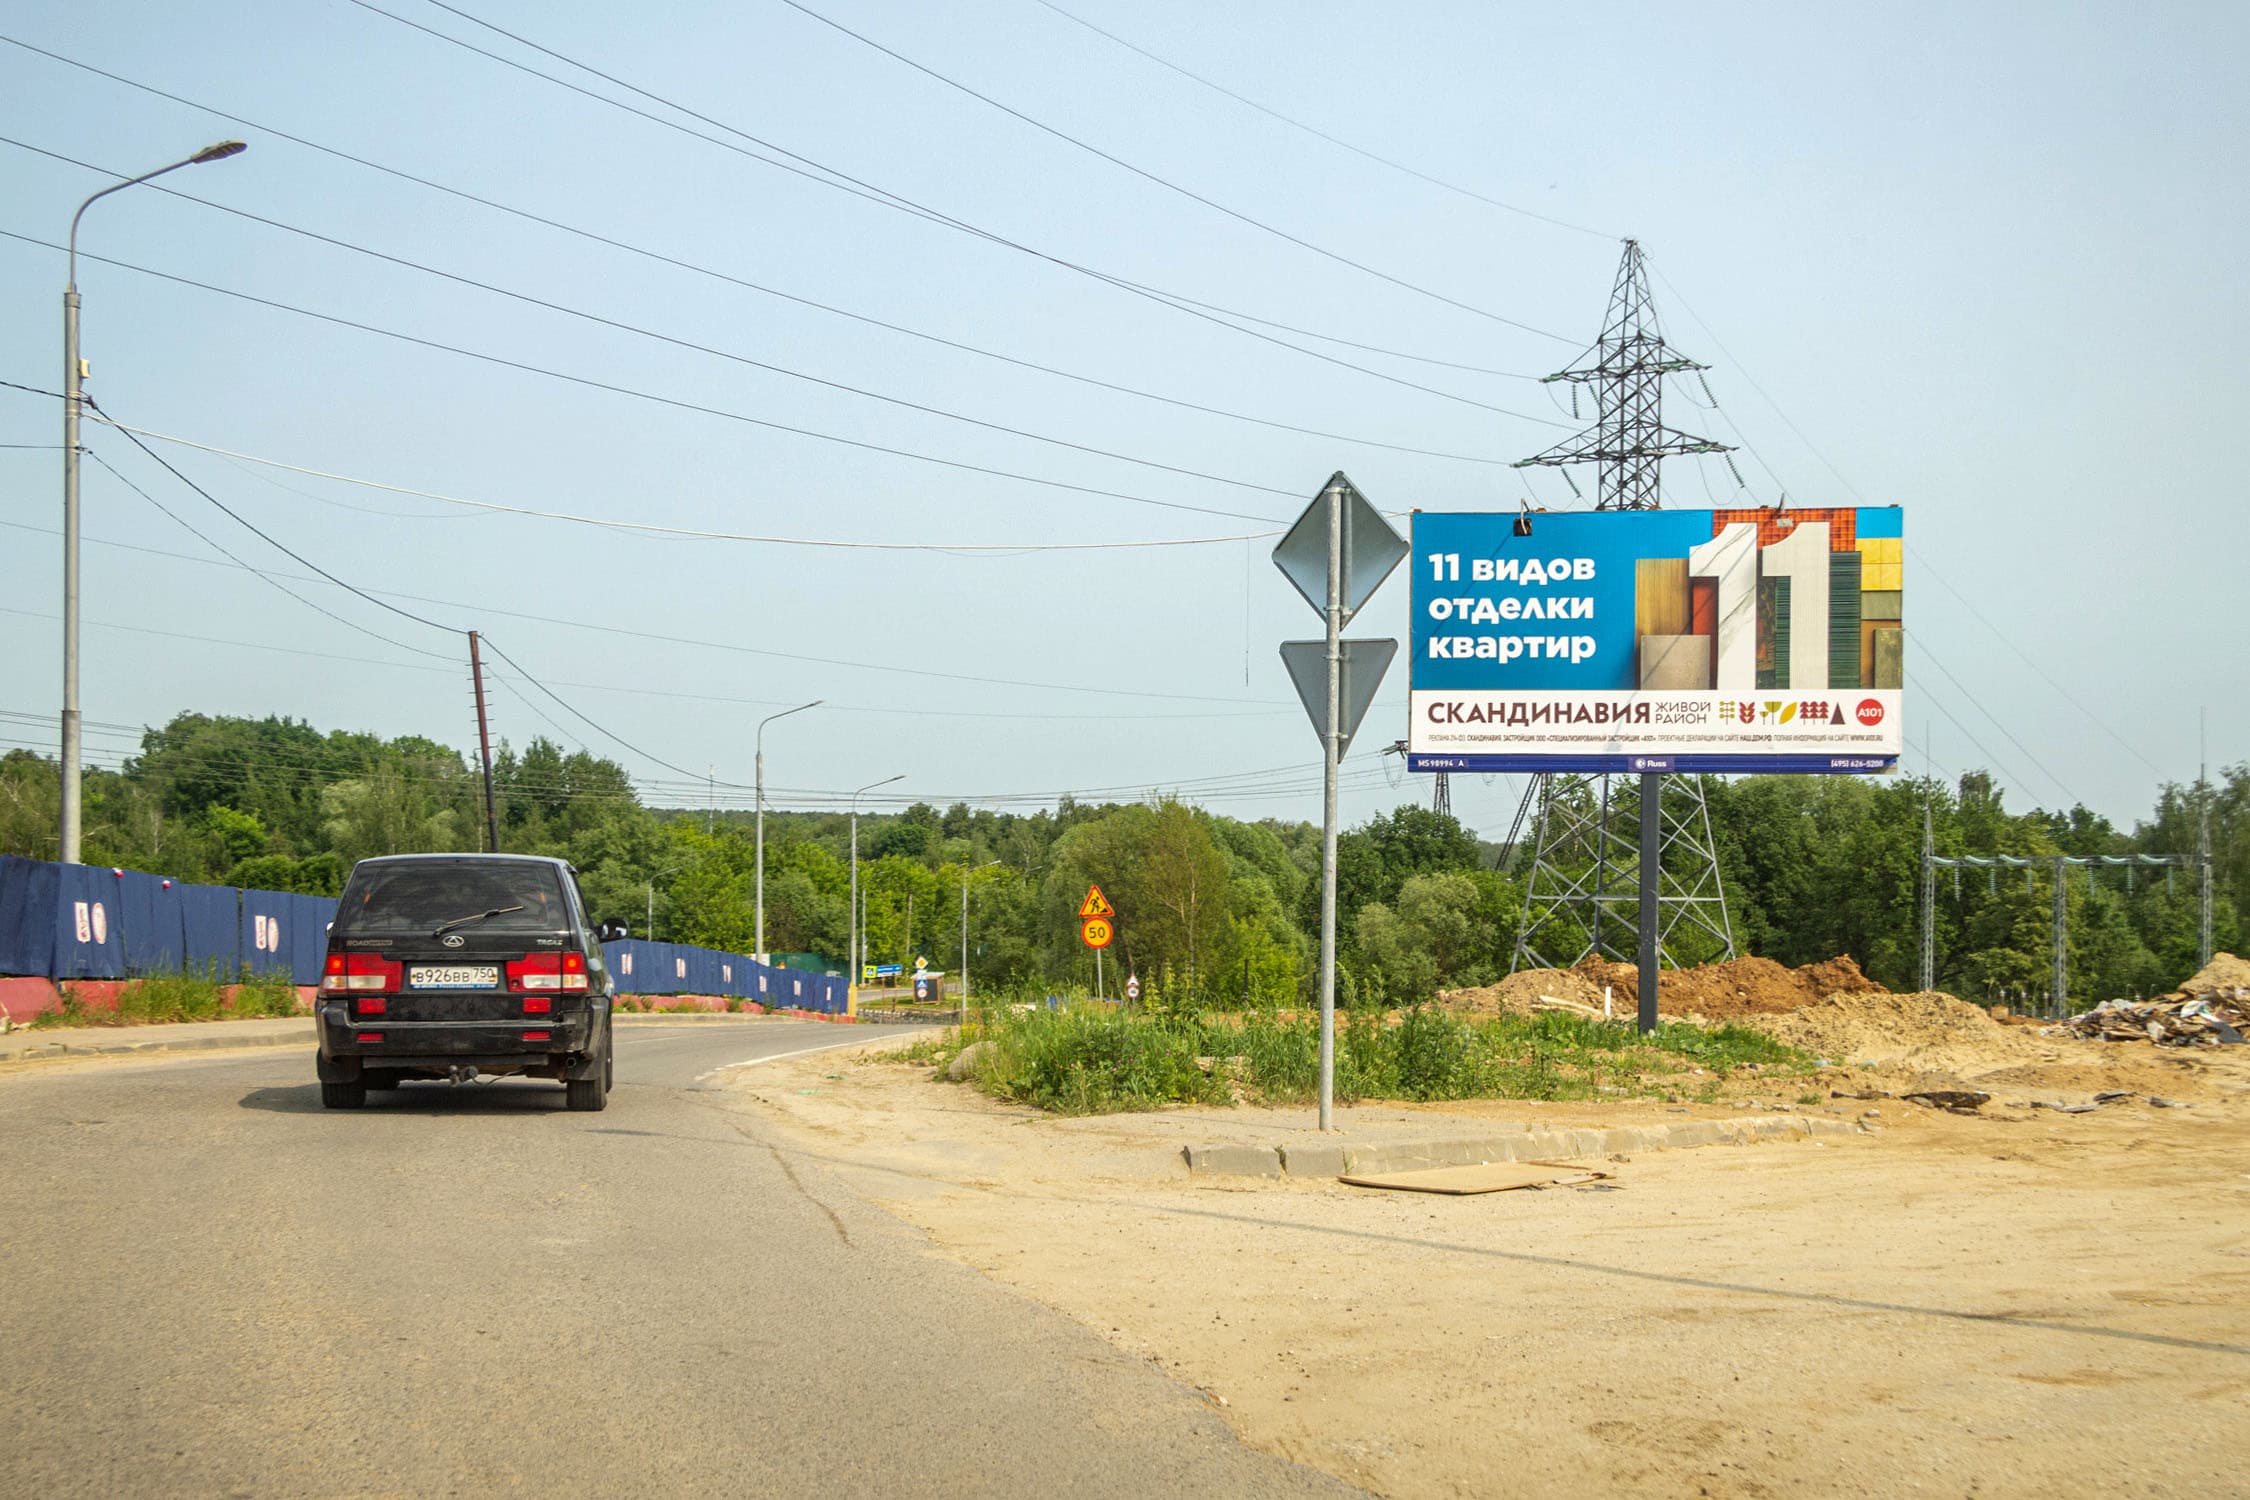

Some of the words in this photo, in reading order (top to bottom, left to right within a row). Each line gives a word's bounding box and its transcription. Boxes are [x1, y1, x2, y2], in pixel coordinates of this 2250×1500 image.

[1428, 553, 1460, 581] 11
[1472, 558, 1596, 586] видов
[1428, 597, 1594, 624] отделки
[1689, 522, 1830, 690] 11
[1428, 635, 1597, 664] квартир
[1427, 702, 1651, 727] СКАНДИНАВИЯ
[1655, 701, 1712, 713] ЖИВОЙ
[1655, 713, 1708, 725] РАЙОН
[1647, 760, 1667, 768] Russ
[1088, 927, 1106, 939] 50
